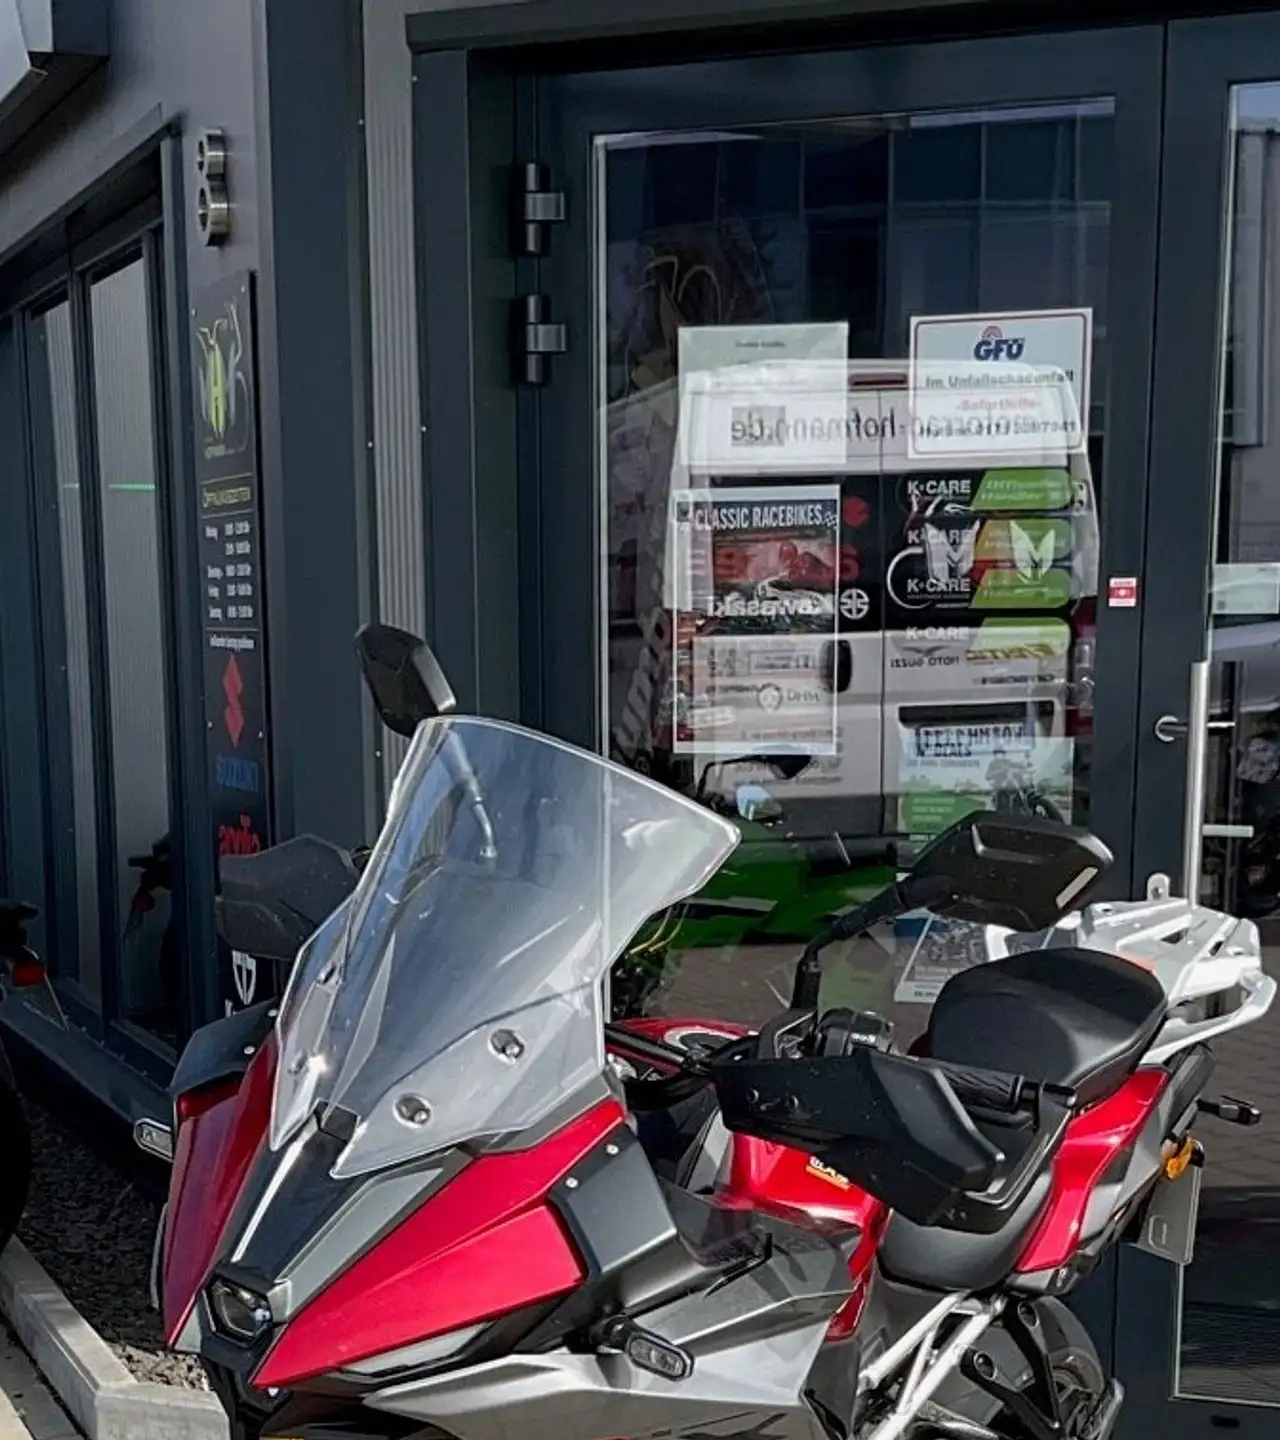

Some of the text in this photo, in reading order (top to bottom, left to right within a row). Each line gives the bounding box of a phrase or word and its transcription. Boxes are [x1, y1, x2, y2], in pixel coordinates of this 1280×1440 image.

[973, 337, 1026, 361] GFÜ
[694, 504, 823, 531] CLASSIC RACEBIKES
